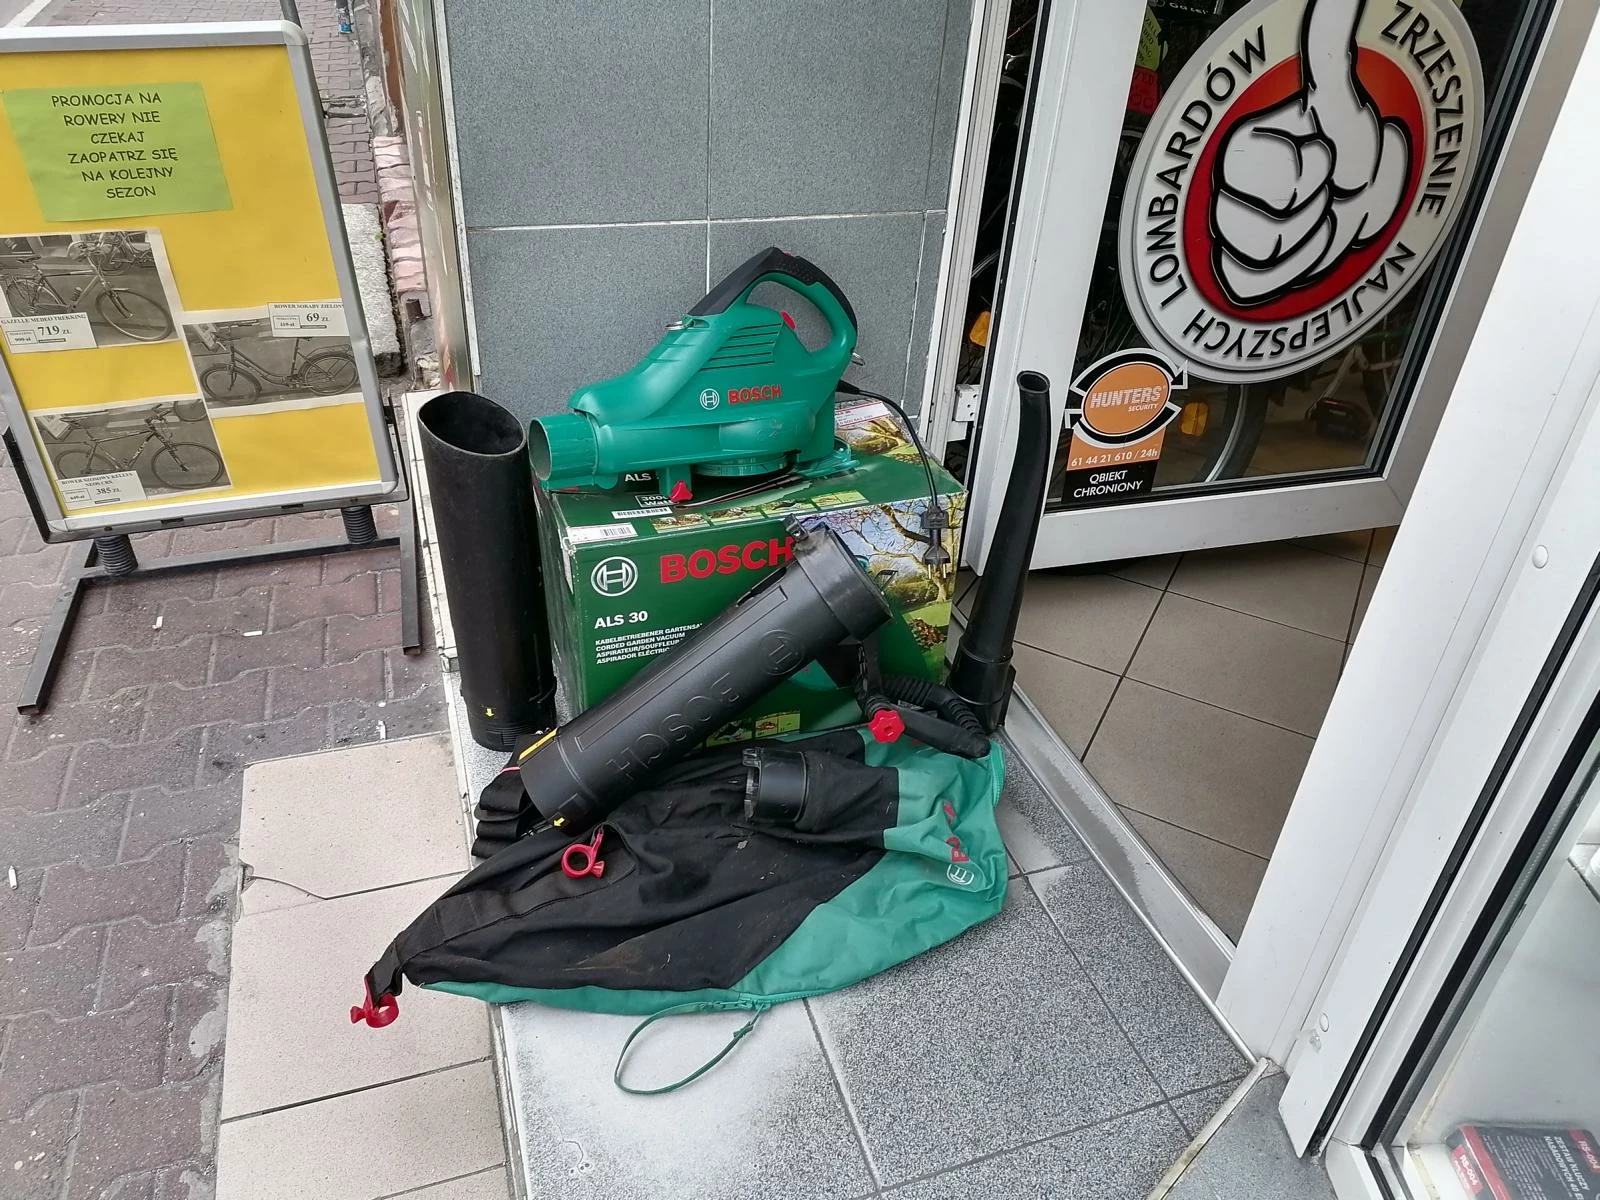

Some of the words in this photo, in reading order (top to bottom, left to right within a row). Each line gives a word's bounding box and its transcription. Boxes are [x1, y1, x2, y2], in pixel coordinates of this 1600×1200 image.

[51, 95, 134, 107] PROMOCJA
[139, 92, 162, 104] NA
[63, 113, 125, 127] ROWERY
[132, 111, 161, 123] NIE
[1380, 4, 1464, 217] ZRZESZENIE
[90, 131, 145, 144] CZEKAJ
[68, 150, 146, 164] ZAOPATRZ
[152, 148, 179, 161] SIĘ
[81, 171, 104, 182] NA
[110, 167, 173, 180] KOLEJNY
[1146, 25, 1267, 308] LOMBARDÓW
[106, 186, 156, 199] SEZON
[1181, 241, 1416, 360] NAJLEPSZYCH
[306, 312, 320, 322] 69
[38, 325, 60, 336] 719
[728, 384, 781, 405] BOSCH
[1090, 386, 1162, 409] HUNTERS
[1128, 403, 1159, 413] SECURITY
[1071, 457, 1082, 467] 61
[1085, 456, 1098, 466] 44
[1100, 454, 1111, 464] 21
[1114, 451, 1132, 463] 610
[1140, 449, 1158, 460] 24h
[625, 473, 651, 482] ALS
[96, 487, 111, 496] 385
[1073, 480, 1143, 498] CHRONIONY
[660, 536, 795, 584] BOSCH
[594, 614, 625, 629] ALS
[629, 611, 648, 623] 30
[595, 630, 664, 645] KABELBETRIEBENER
[665, 623, 703, 634] GARTENSA
[596, 642, 625, 652] CORDED
[626, 638, 655, 647] GARDEN
[656, 632, 686, 641] VACUUM
[596, 653, 637, 665] ASPIRADOR
[1570, 1163, 1590, 1190] KLUCZY
